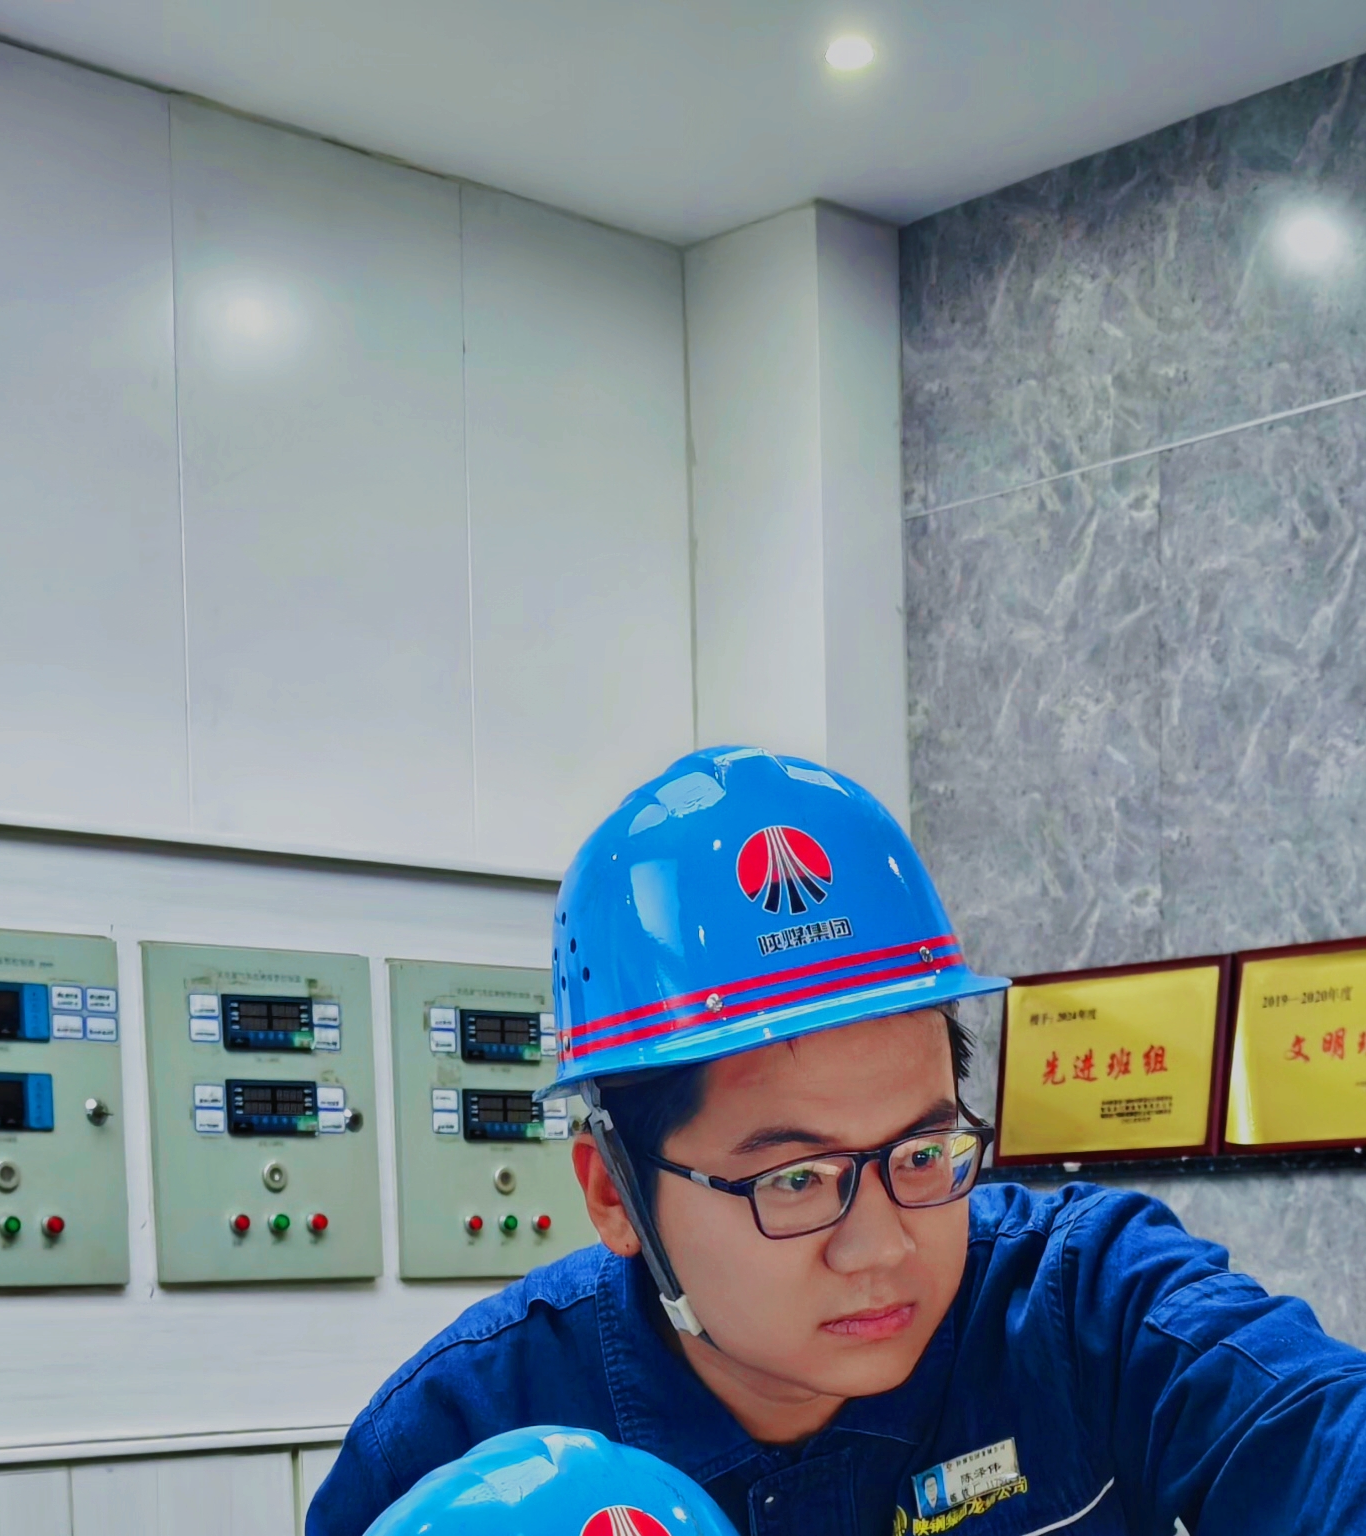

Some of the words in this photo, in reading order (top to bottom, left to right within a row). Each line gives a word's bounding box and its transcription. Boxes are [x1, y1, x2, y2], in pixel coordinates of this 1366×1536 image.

[756, 917, 852, 956] 陕煤集团
[1042, 1044, 1168, 1086] 先进班组
